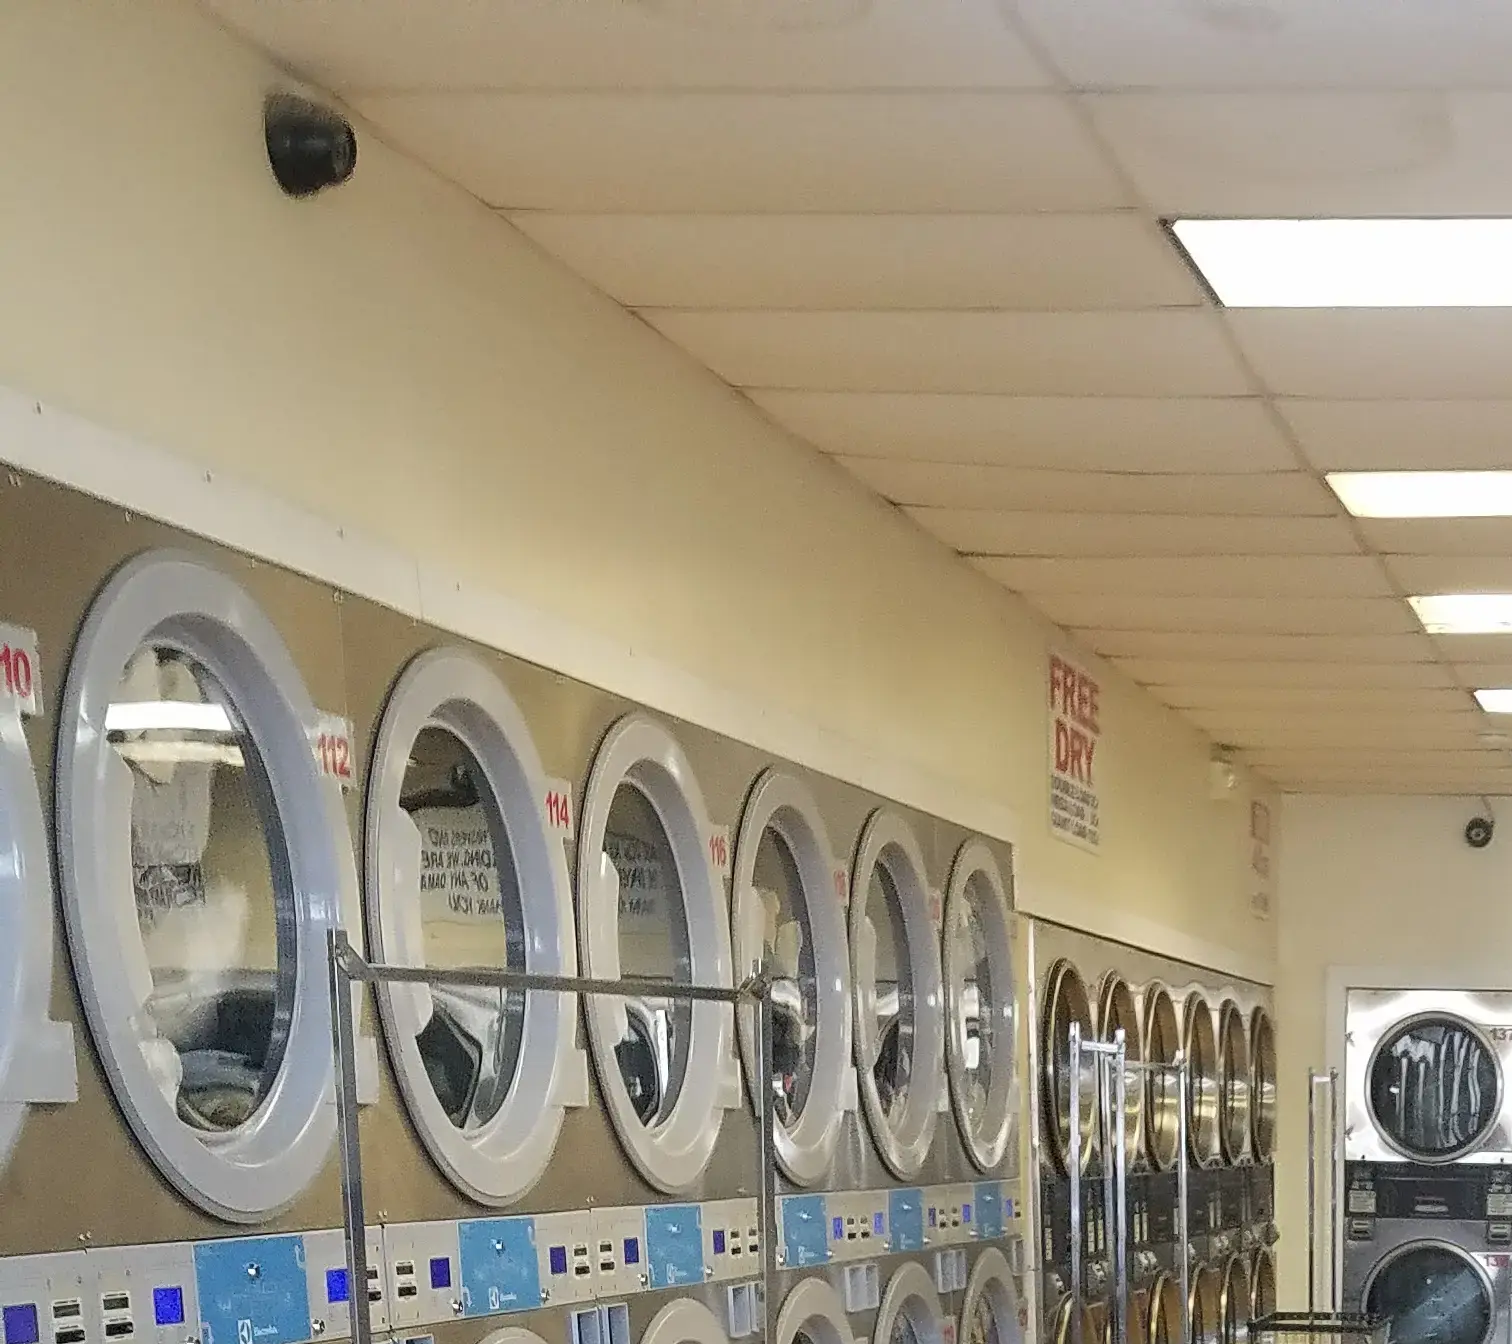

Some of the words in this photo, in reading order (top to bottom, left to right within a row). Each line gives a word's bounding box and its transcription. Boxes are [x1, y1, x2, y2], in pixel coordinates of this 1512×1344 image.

[1050, 655, 1101, 734] FREE
[316, 733, 349, 777] 112
[1055, 718, 1095, 788] DRY
[545, 790, 569, 829] 114
[709, 835, 726, 867] 116
